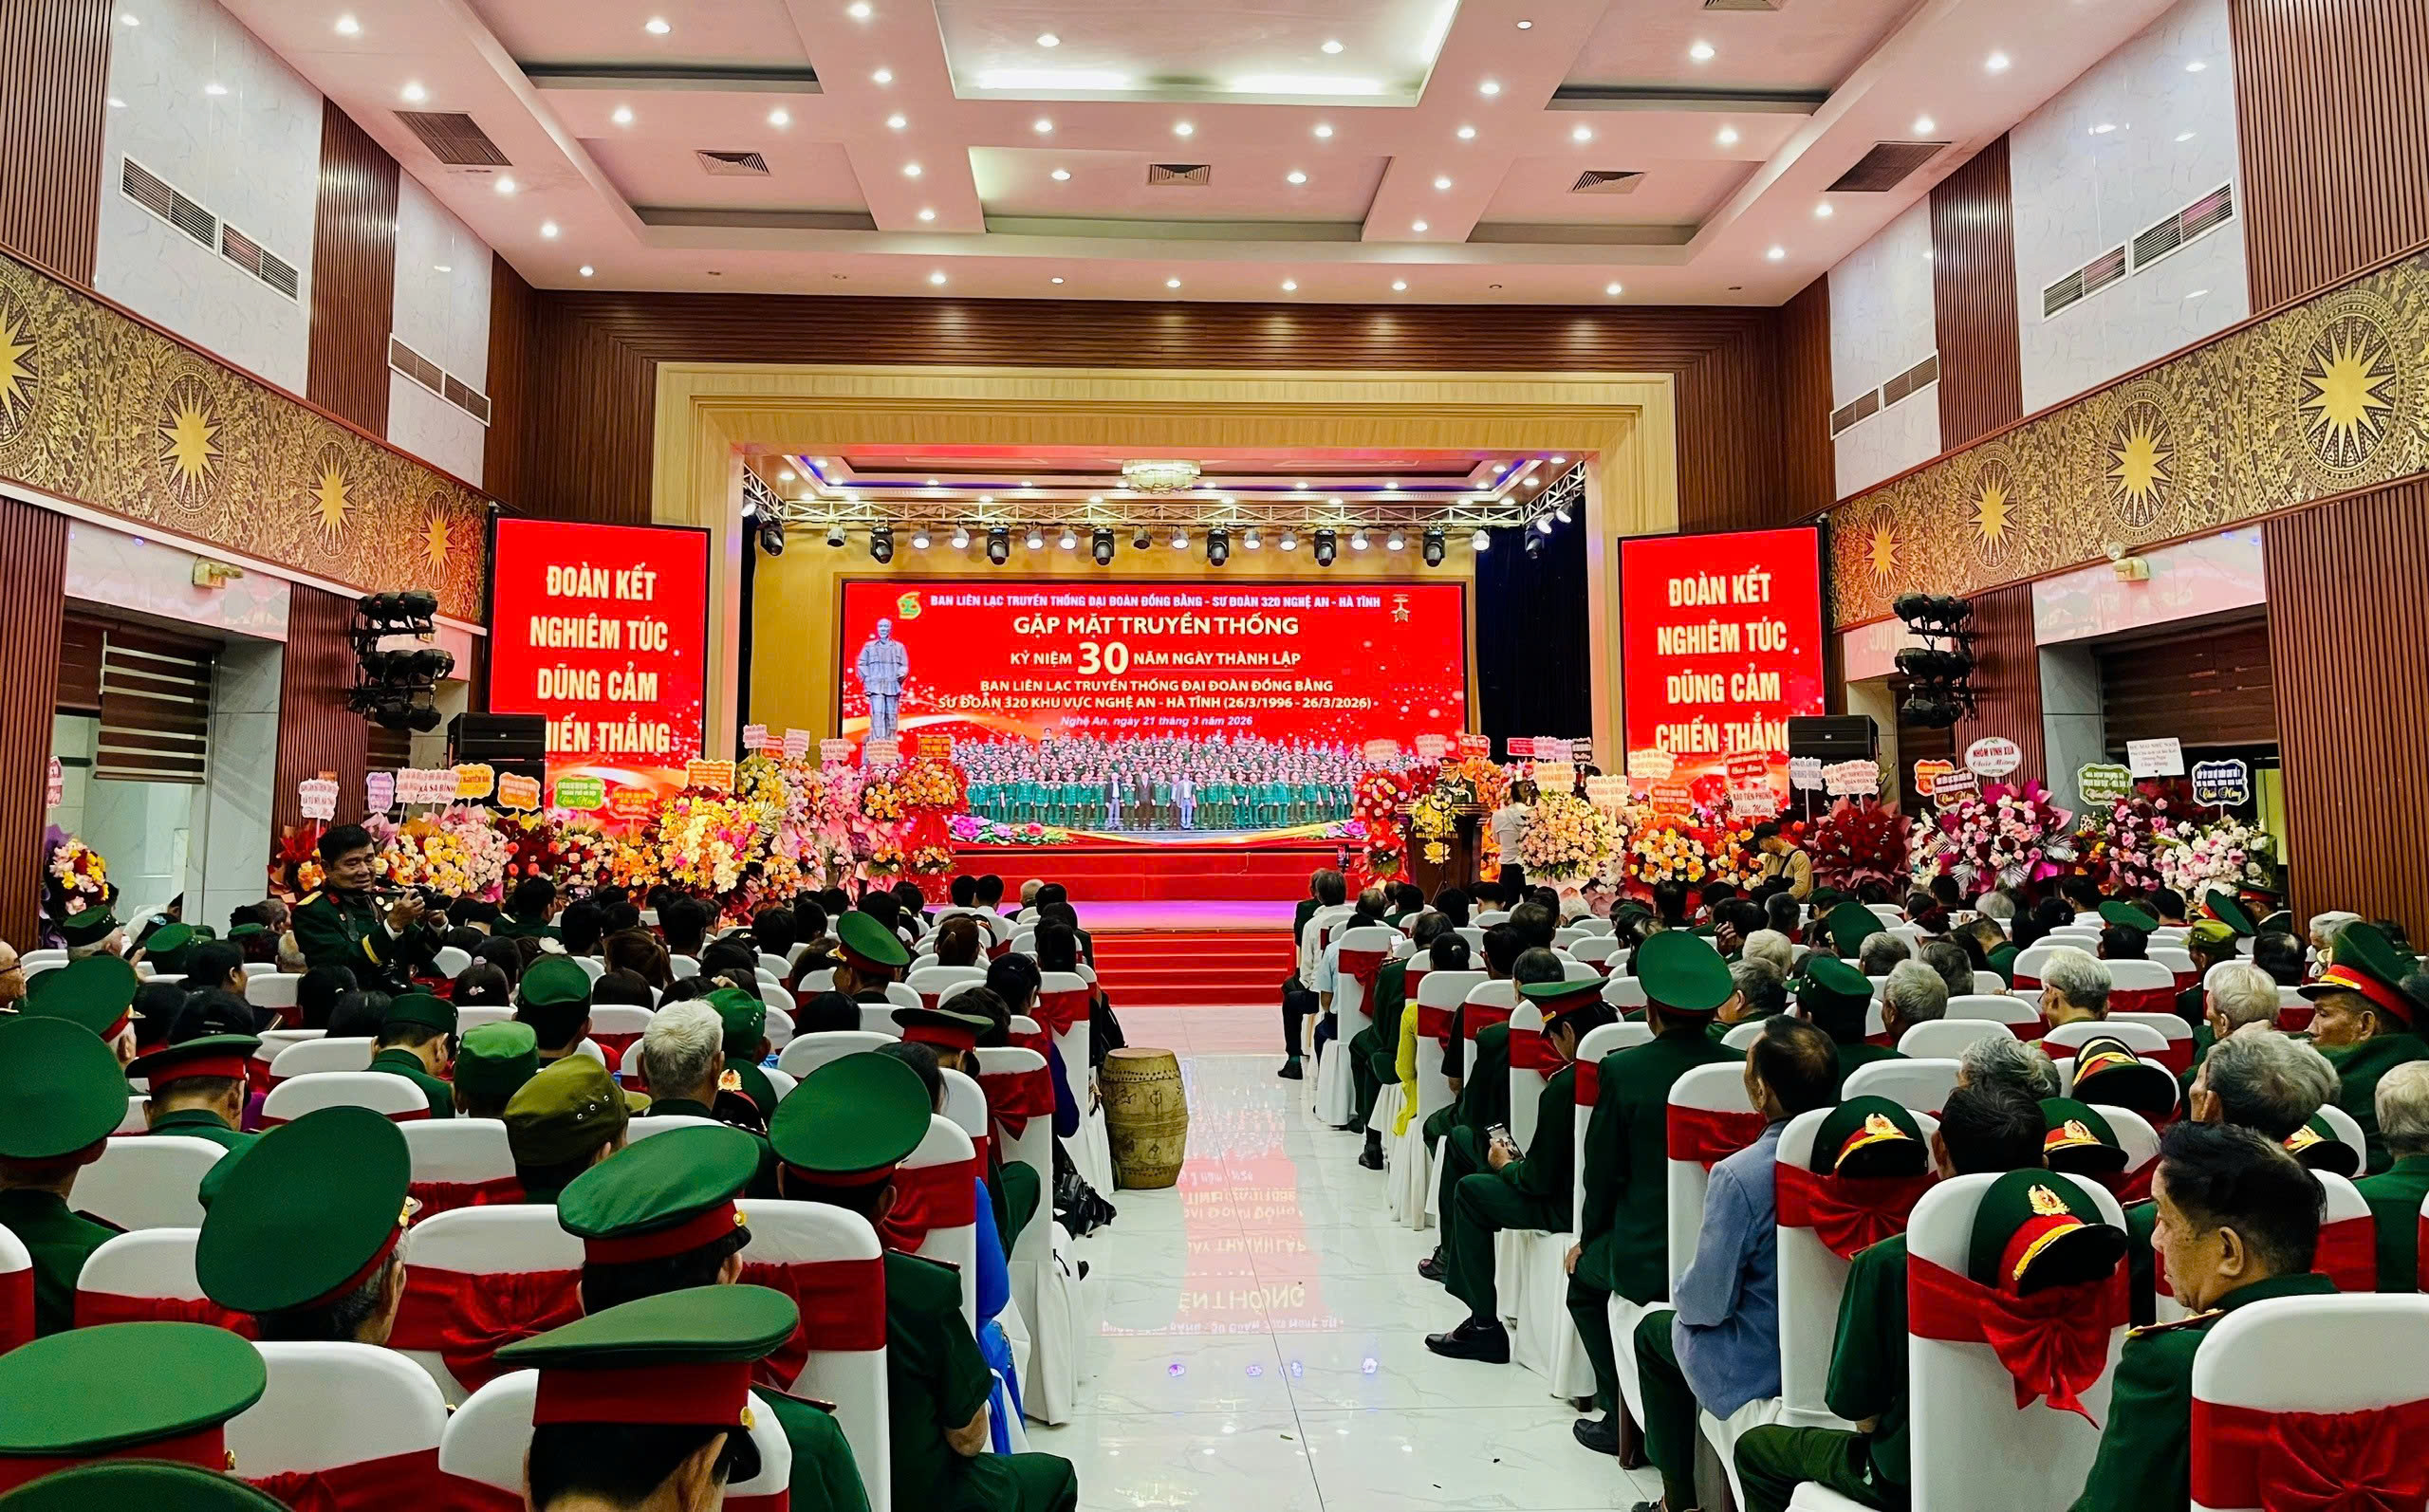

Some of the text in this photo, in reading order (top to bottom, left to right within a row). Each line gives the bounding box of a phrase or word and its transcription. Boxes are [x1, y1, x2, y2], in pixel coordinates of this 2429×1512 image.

[546, 562, 657, 600] ĐOÀN KẾT
[1668, 564, 1771, 607] ĐOÀN KẾT
[931, 596, 954, 606] BAN
[956, 594, 980, 606] LIÊN
[983, 596, 1004, 608] LẠC
[1050, 593, 1085, 606] THỐNG
[1088, 596, 1106, 608] ĐẠI
[1109, 595, 1139, 606] ĐOÀN
[1213, 596, 1228, 606] SƯ
[1230, 595, 1259, 607] ĐOÀN
[1261, 597, 1281, 607] 320
[1283, 595, 1311, 609] NGHỆ
[1314, 597, 1330, 607] AN
[1339, 595, 1353, 607] HÀ
[1356, 596, 1381, 607] TĨNH
[529, 613, 668, 652] NGHIÊM TÚC
[1012, 612, 1299, 637] GẶP MẶT TRUYỀN THỐNG
[1658, 616, 1787, 655] NGHIÊM TÚC
[1011, 641, 1301, 674] KỶ NIỆM 30 NĂM NGÀY THÀNH LẬP
[537, 661, 658, 702] DŨNG CẢM
[980, 680, 1010, 691] BAN
[1013, 678, 1043, 691] LIÊN
[1047, 681, 1071, 694] LẠC
[1130, 678, 1178, 691] THỐNG
[1181, 681, 1206, 693] ĐẠI
[1208, 678, 1249, 691] ĐOÀN
[1667, 662, 1781, 704] DŨNG CẢM
[938, 697, 958, 709] SƯ
[960, 695, 1001, 709] ĐOÀN
[1005, 697, 1029, 709] 320
[1031, 697, 1061, 709] KHU
[1064, 697, 1092, 710] VỰC
[1094, 695, 1134, 711] NGHỆ
[1136, 697, 1156, 709] AN
[1166, 695, 1186, 709] HÀ
[1188, 695, 1221, 709] TĨNH
[1223, 697, 1292, 710] (26/3/1996
[1303, 697, 1372, 710] 26/3/2026)
[1060, 715, 1090, 727] Nghệ
[1113, 716, 1140, 728] ngày
[1159, 716, 1189, 727] tháng
[1201, 716, 1225, 725] năm
[545, 711, 670, 753] IẾN THẮNG
[1656, 714, 1718, 752] CHIẾN
